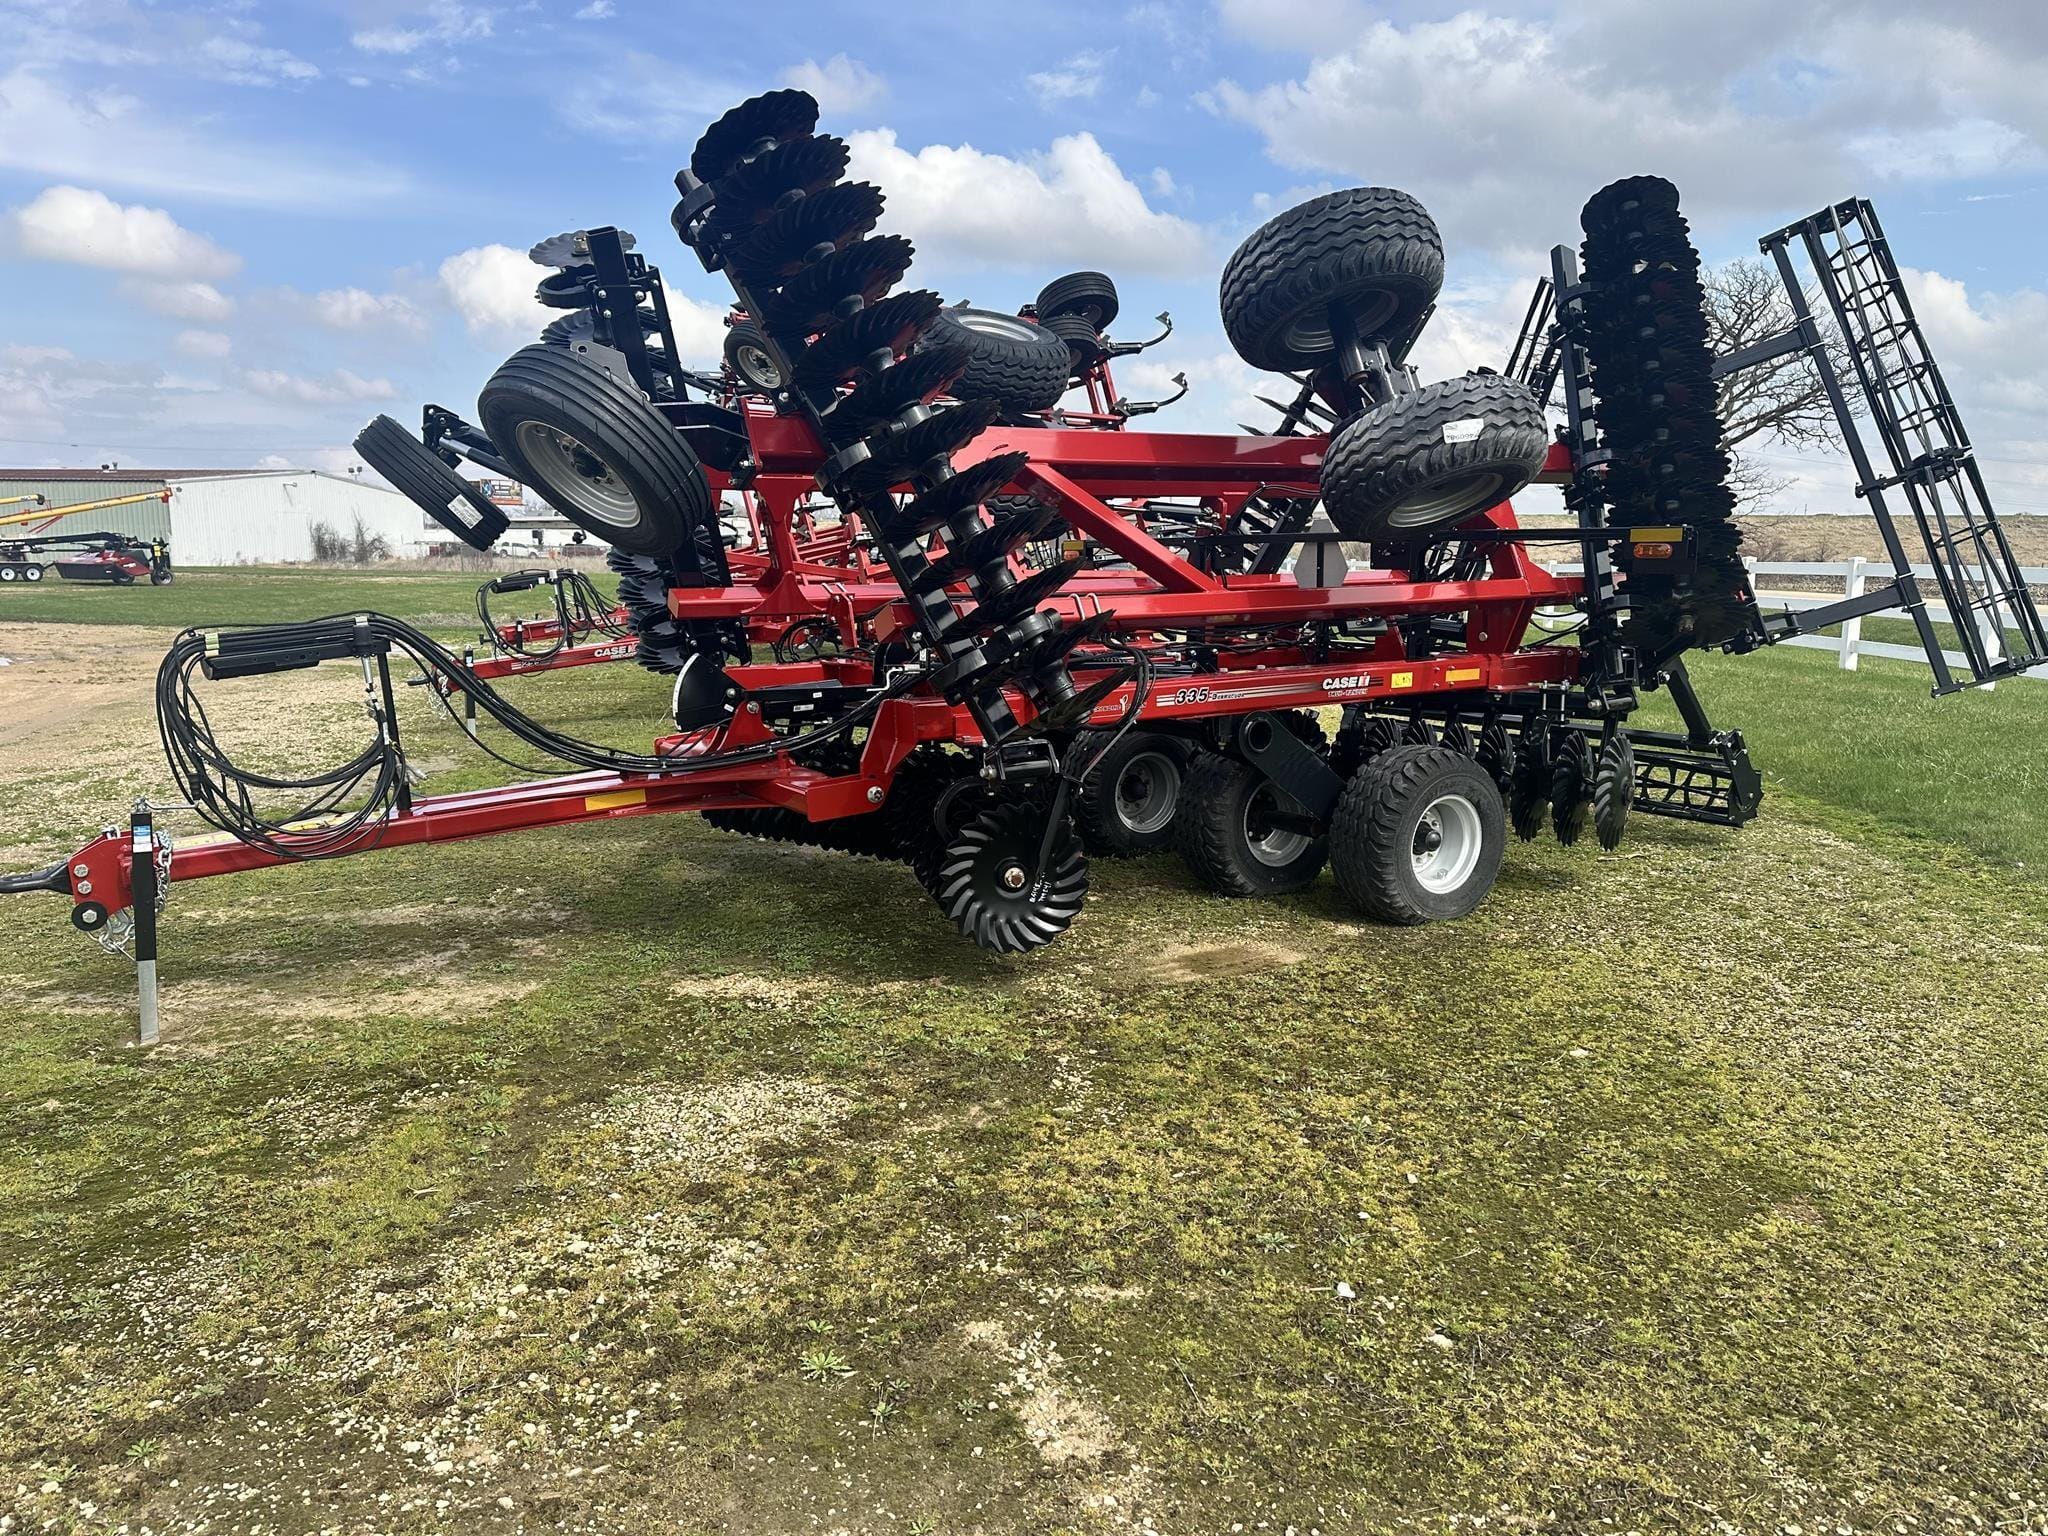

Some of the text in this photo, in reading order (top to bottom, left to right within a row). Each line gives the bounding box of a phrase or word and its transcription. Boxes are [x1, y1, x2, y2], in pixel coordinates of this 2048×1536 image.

[594, 646, 627, 657] CASE
[1322, 676, 1358, 690] CASE
[1174, 686, 1210, 706] 335
